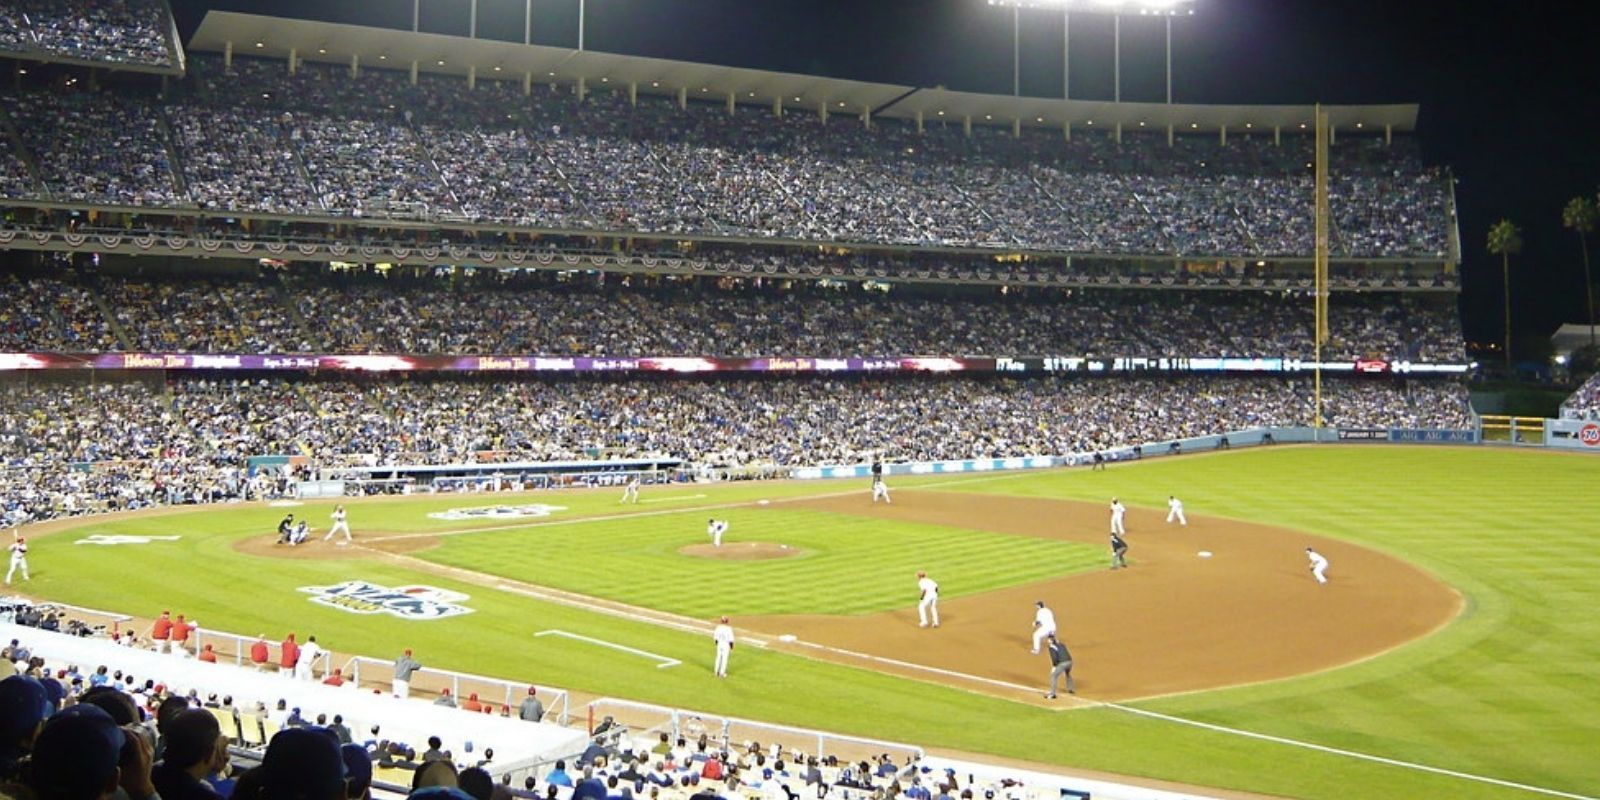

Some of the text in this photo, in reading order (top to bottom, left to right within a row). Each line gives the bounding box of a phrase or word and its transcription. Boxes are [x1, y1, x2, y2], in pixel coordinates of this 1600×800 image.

[1402, 430, 1467, 440] AIG AIG AIG
[1582, 429, 1597, 442] 76
